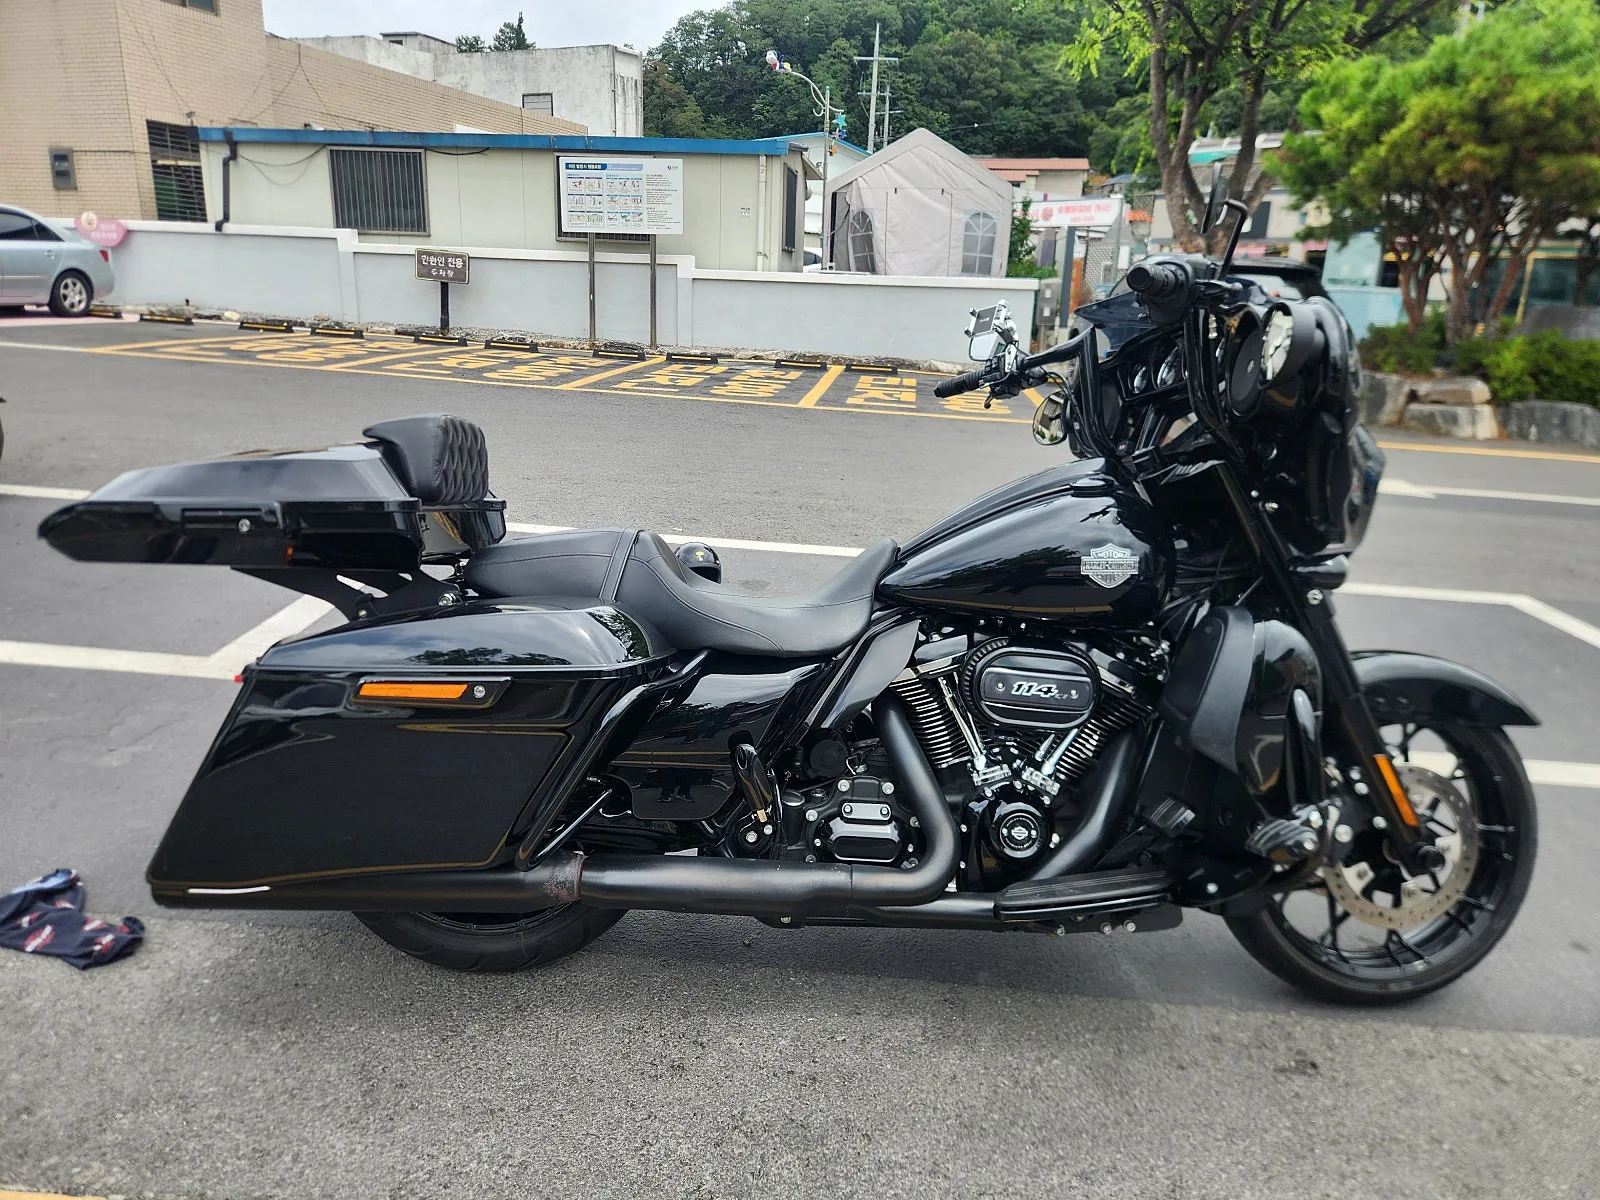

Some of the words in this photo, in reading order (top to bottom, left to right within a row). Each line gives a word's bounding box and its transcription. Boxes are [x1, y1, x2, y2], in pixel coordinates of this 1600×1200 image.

[421, 254, 445, 267] 민원인
[447, 257, 464, 269] 전용
[1011, 681, 1058, 698] 114
